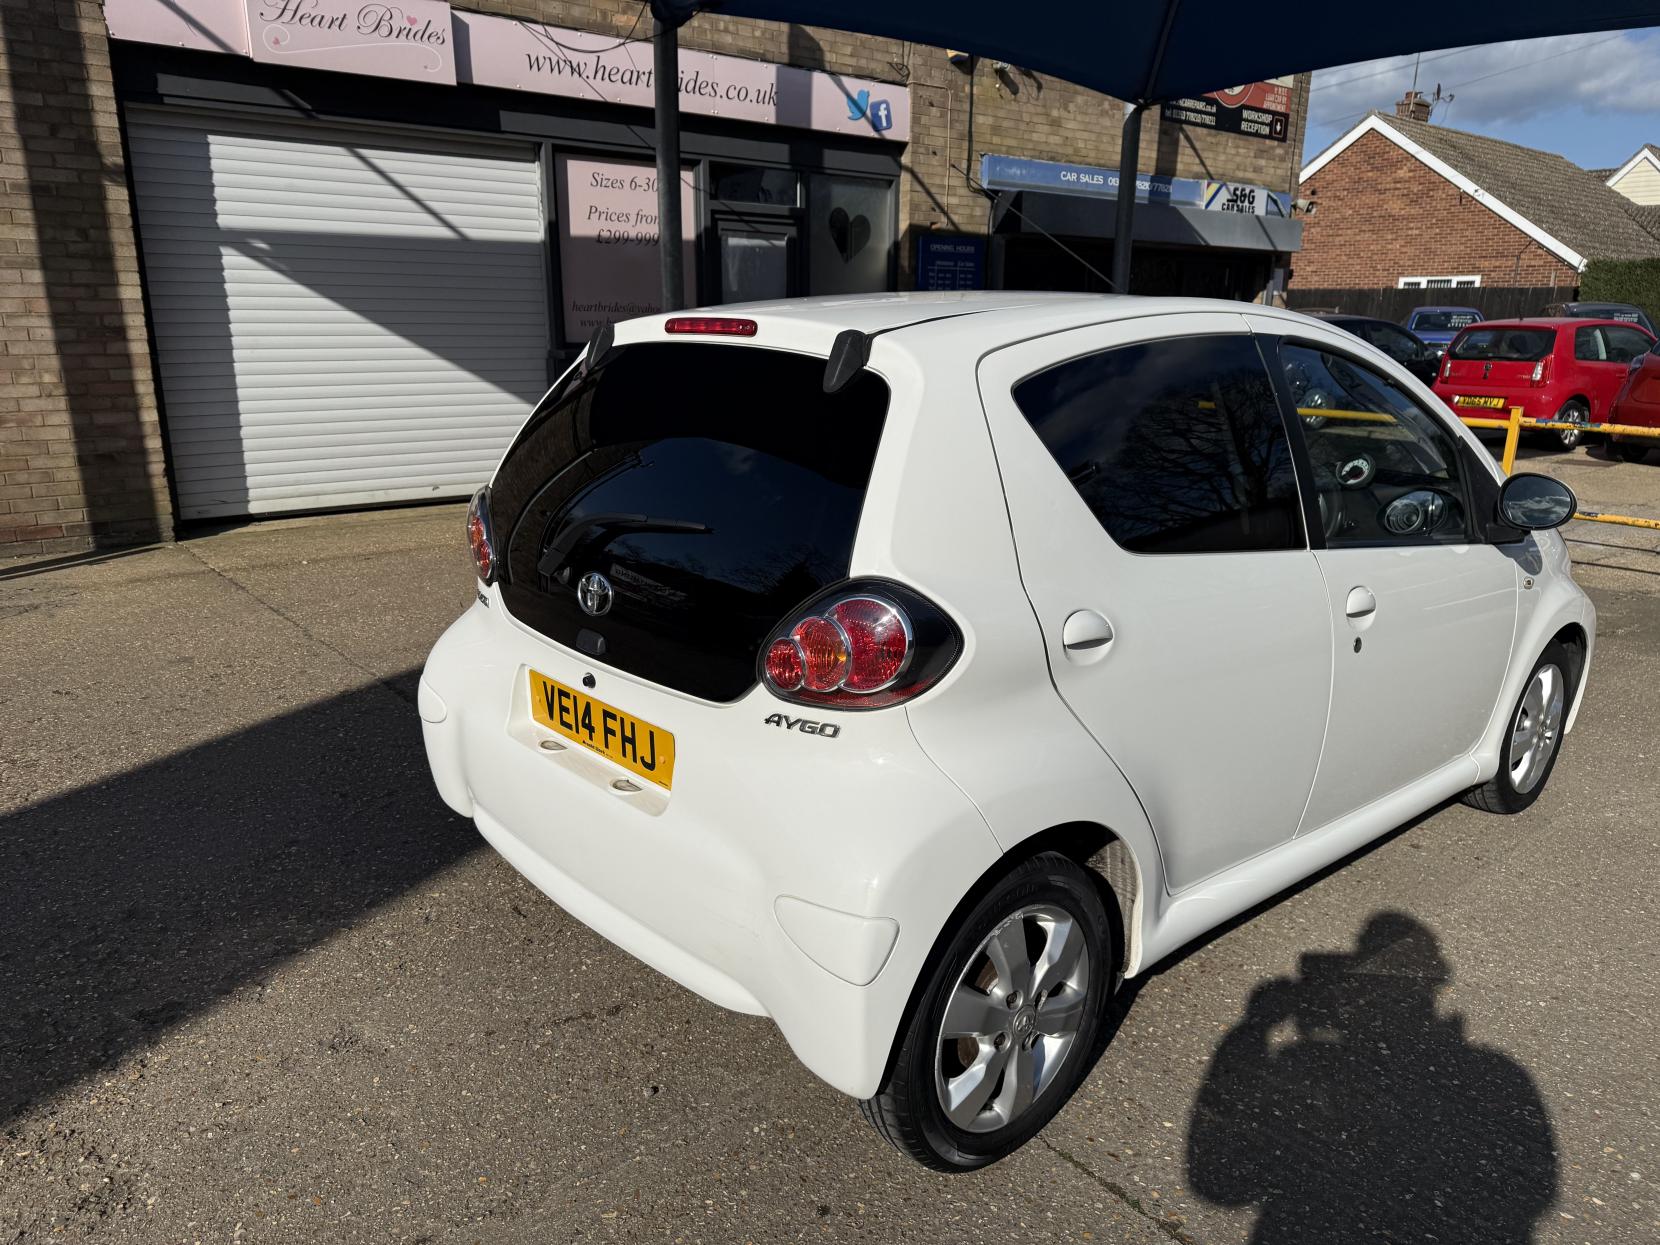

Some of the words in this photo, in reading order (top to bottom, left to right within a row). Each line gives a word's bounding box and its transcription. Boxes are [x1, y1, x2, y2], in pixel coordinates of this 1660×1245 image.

[260, 0, 348, 31] Heart
[356, 4, 447, 46] Brides
[525, 51, 778, 107] www.heartides.co.uk
[1242, 109, 1273, 124] WORKSHOP
[1241, 121, 1270, 135] RECEPTION
[590, 172, 625, 190] Sizes
[1060, 171, 1077, 182] CAR
[1080, 173, 1104, 185] SALES
[1227, 187, 1256, 205] S&G
[587, 205, 631, 224] Prices
[1222, 202, 1235, 212] CAR
[1236, 204, 1256, 214] SALES
[542, 680, 596, 742] VE14
[603, 712, 657, 772] FHJ
[764, 712, 842, 739] AYGO
